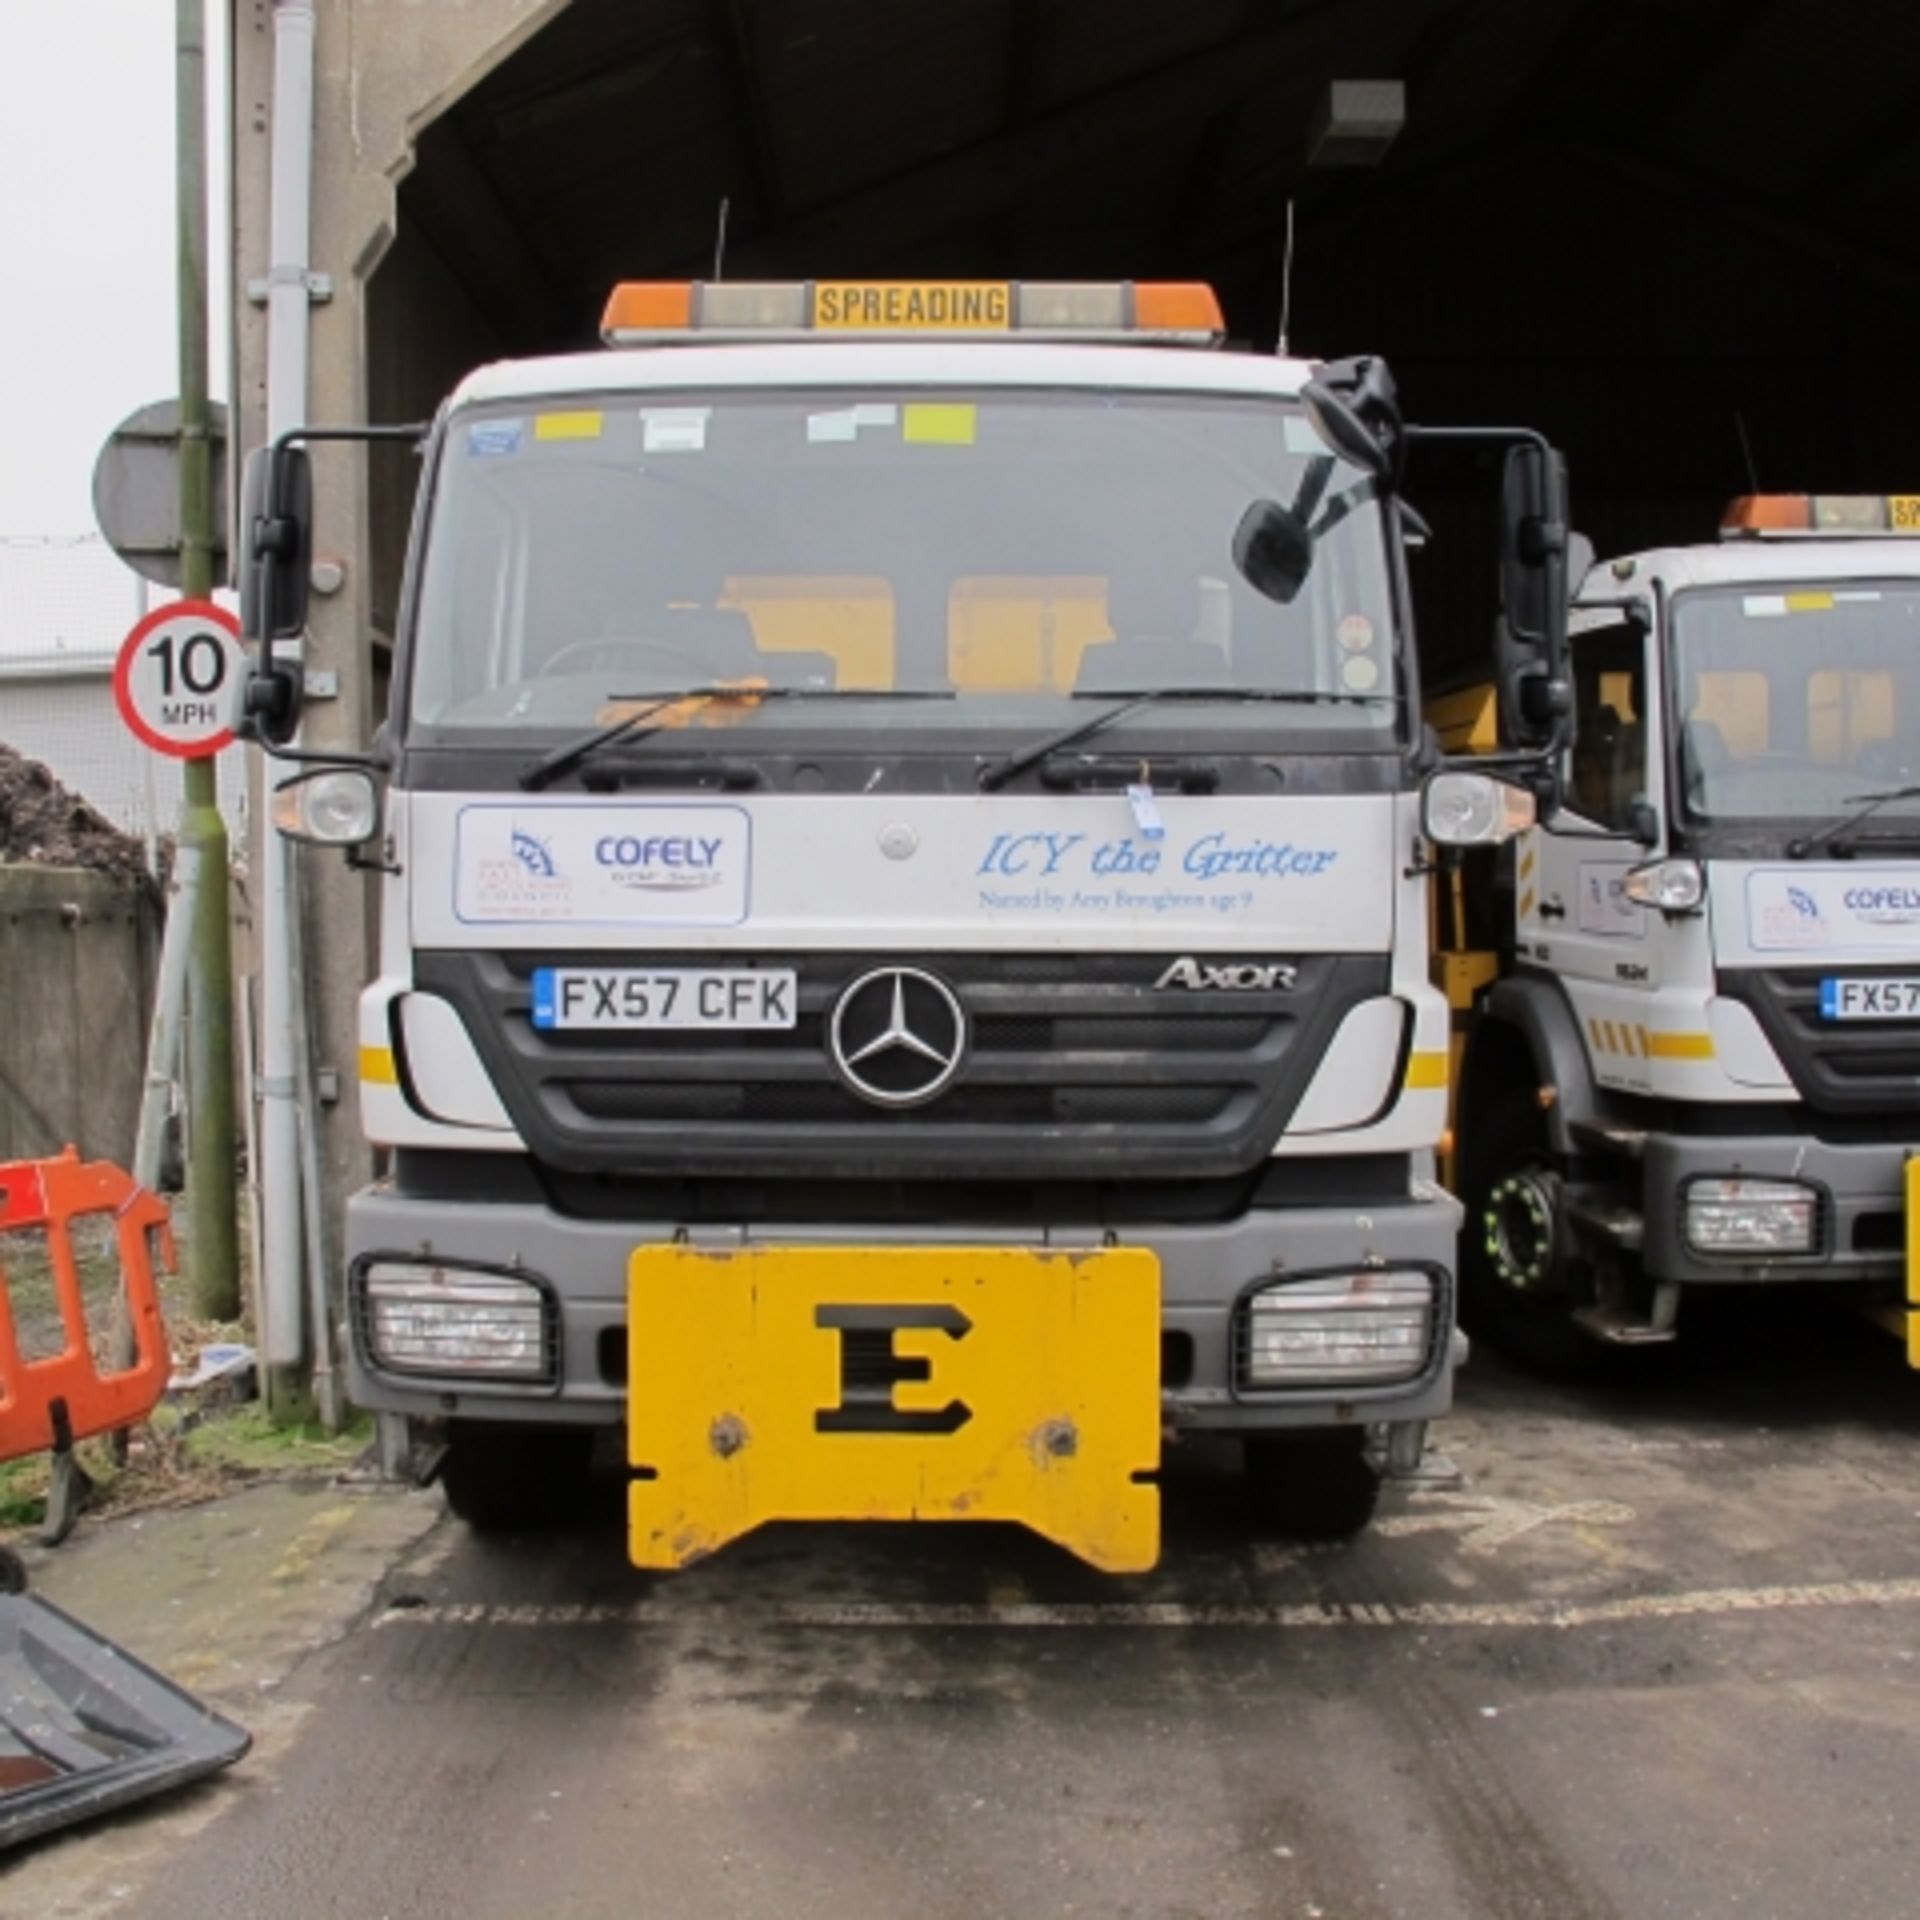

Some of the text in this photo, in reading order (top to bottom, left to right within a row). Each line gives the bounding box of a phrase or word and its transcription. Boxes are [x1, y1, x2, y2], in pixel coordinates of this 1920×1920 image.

[819, 286, 1005, 323] SPREADING
[147, 632, 225, 696] 10
[162, 704, 217, 724] MPH
[595, 836, 723, 866] COFELY
[977, 832, 1337, 880] ICY the Gritter
[562, 978, 788, 1020] FX57 CFK
[1843, 983, 1920, 1012] FX57
[815, 1304, 973, 1433] E
